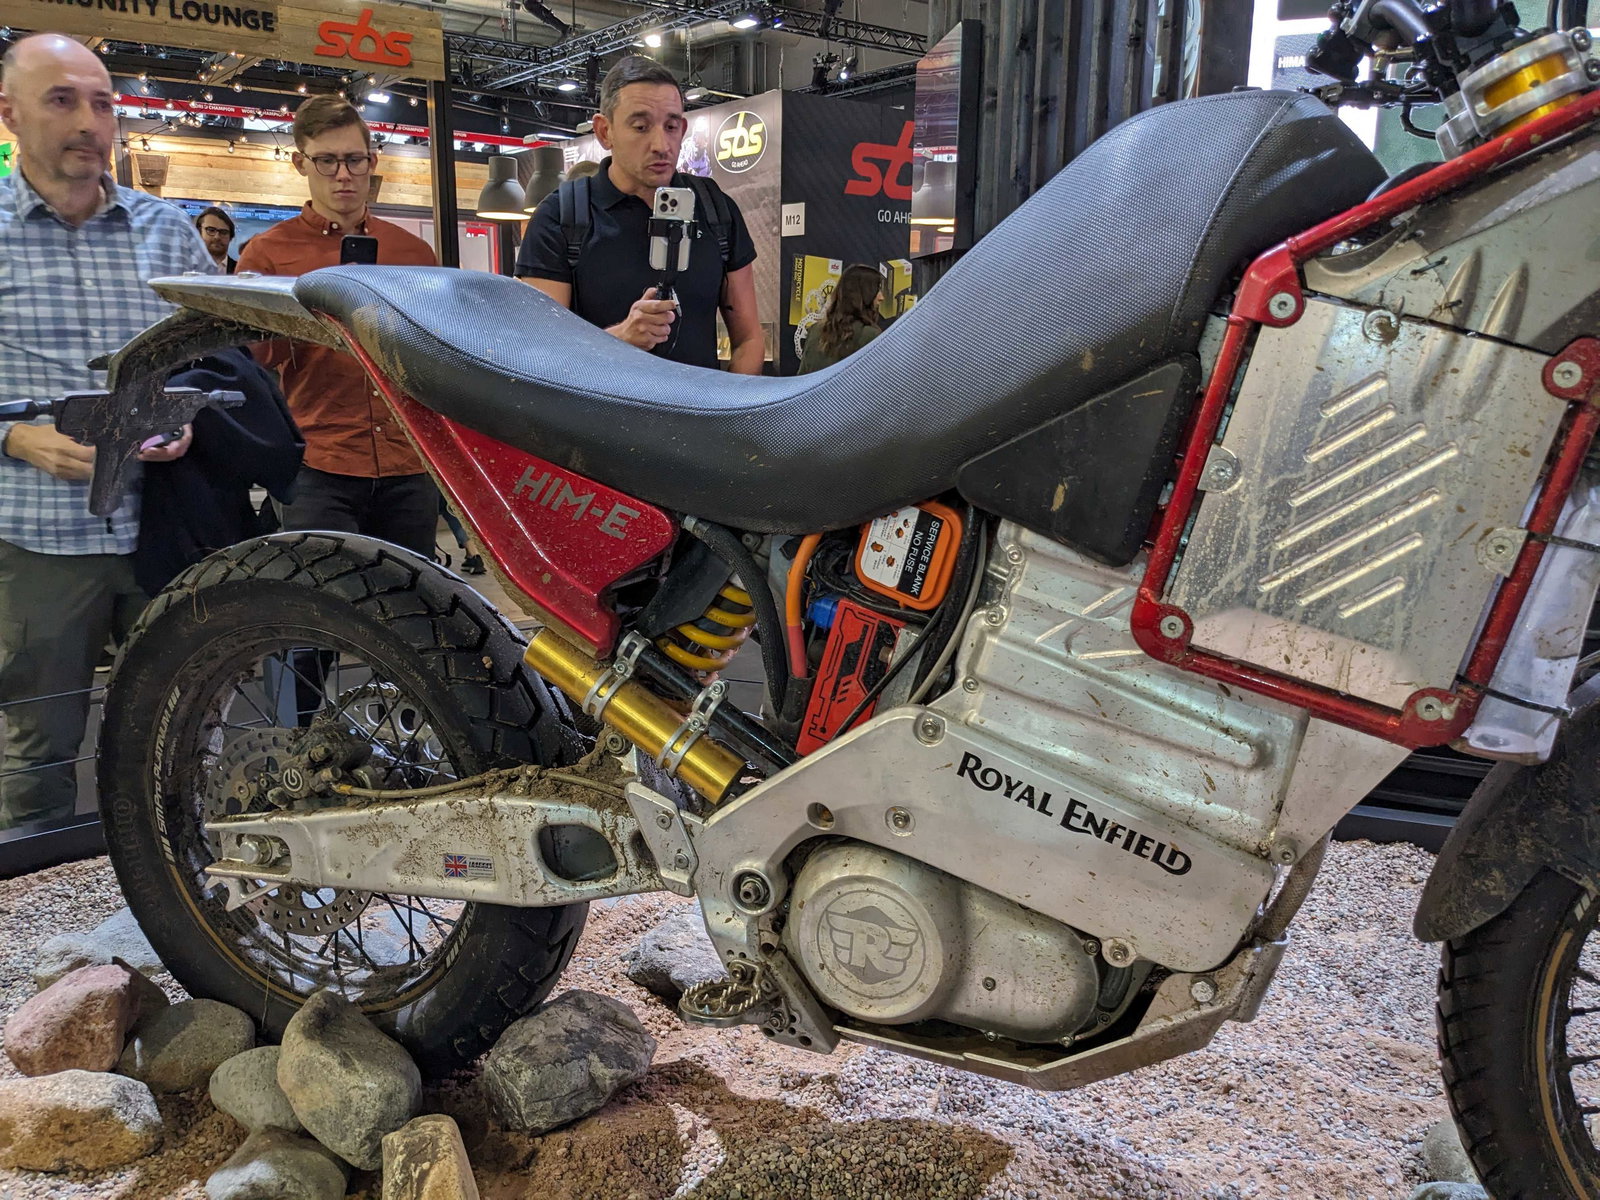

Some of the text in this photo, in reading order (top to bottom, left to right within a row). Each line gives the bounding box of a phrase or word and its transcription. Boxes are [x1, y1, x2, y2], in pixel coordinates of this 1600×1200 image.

[169, 0, 275, 32] LOUNGE
[314, 8, 413, 66] sbs
[717, 112, 764, 161] sbs
[785, 214, 802, 226] M12
[877, 209, 892, 223] GO
[795, 258, 804, 302] MOTORCYCLE
[512, 465, 641, 540] HIM-E
[904, 530, 924, 573] NO FUSE
[910, 520, 940, 595] SERVICE BLANK
[153, 709, 172, 780] PLATINUM
[956, 751, 1193, 876] ROYAL ENFIELD
